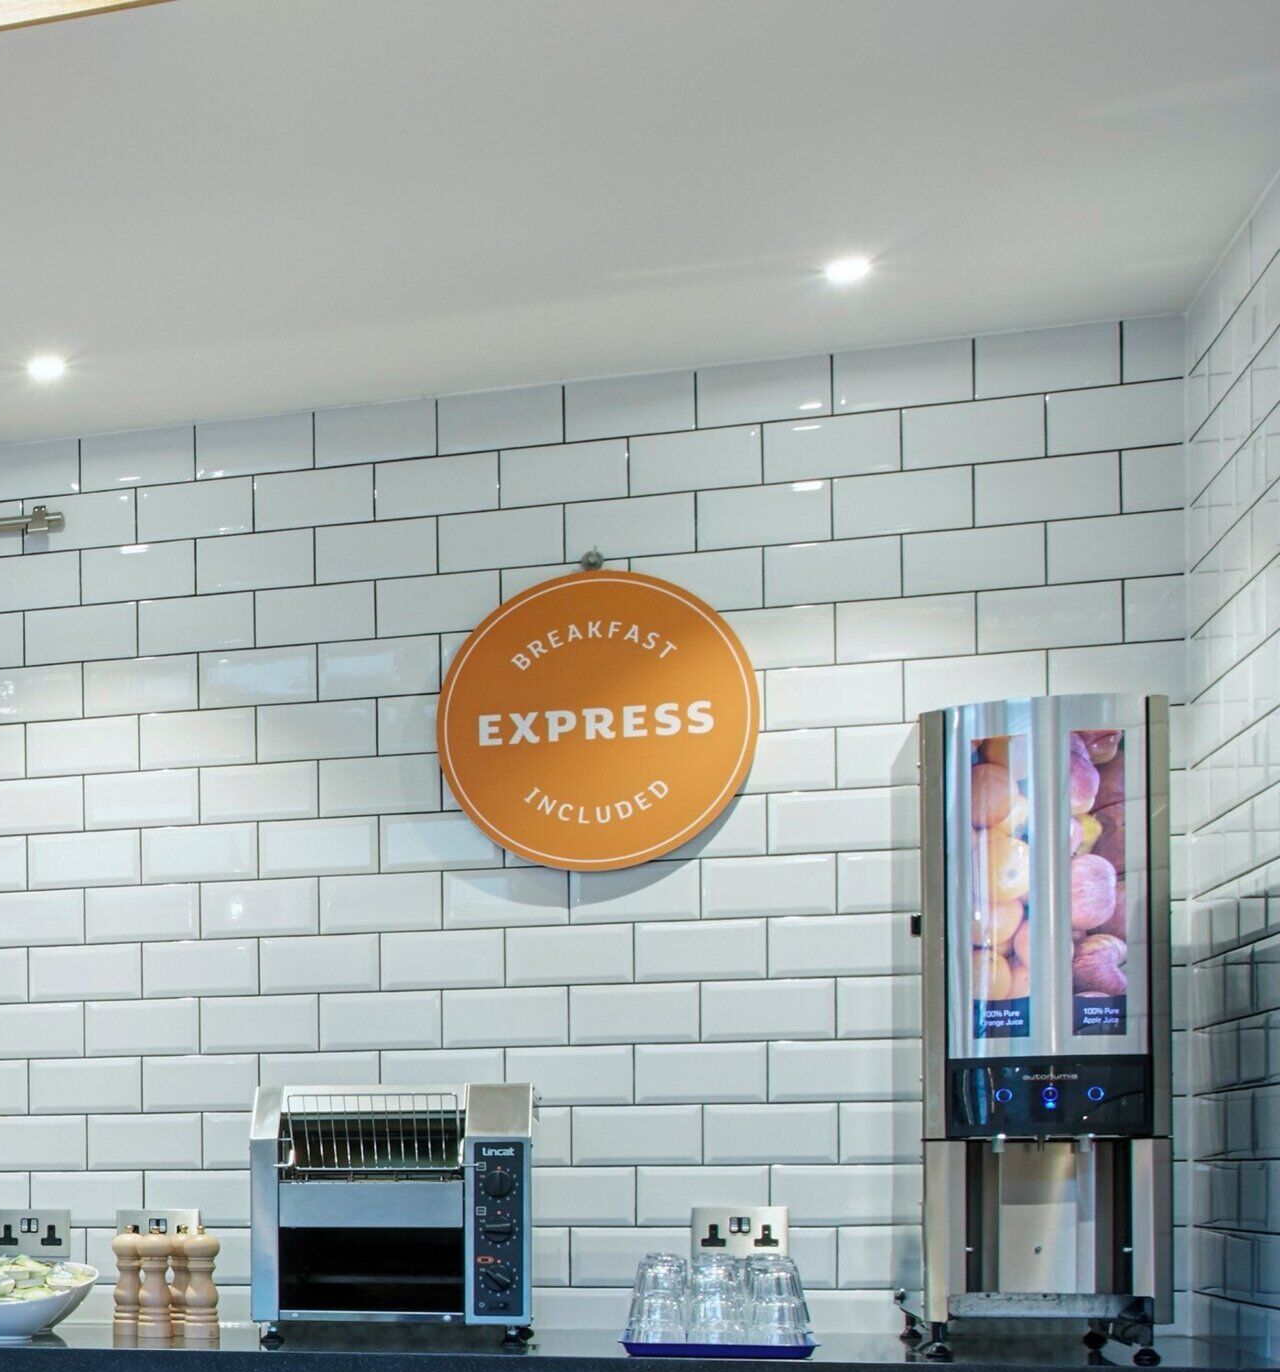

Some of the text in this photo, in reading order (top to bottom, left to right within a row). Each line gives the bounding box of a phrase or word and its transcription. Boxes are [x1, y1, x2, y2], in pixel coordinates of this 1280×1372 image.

[510, 620, 678, 672] BREAKFAST
[478, 700, 715, 747] EXPRESS
[523, 779, 670, 824] INCLUDED
[1003, 1009, 1021, 1018] Pure
[1083, 1007, 1120, 1016] 100% Pure
[981, 1018, 1024, 1028] Orange Juice
[1082, 1016, 1120, 1025] Apple Juice
